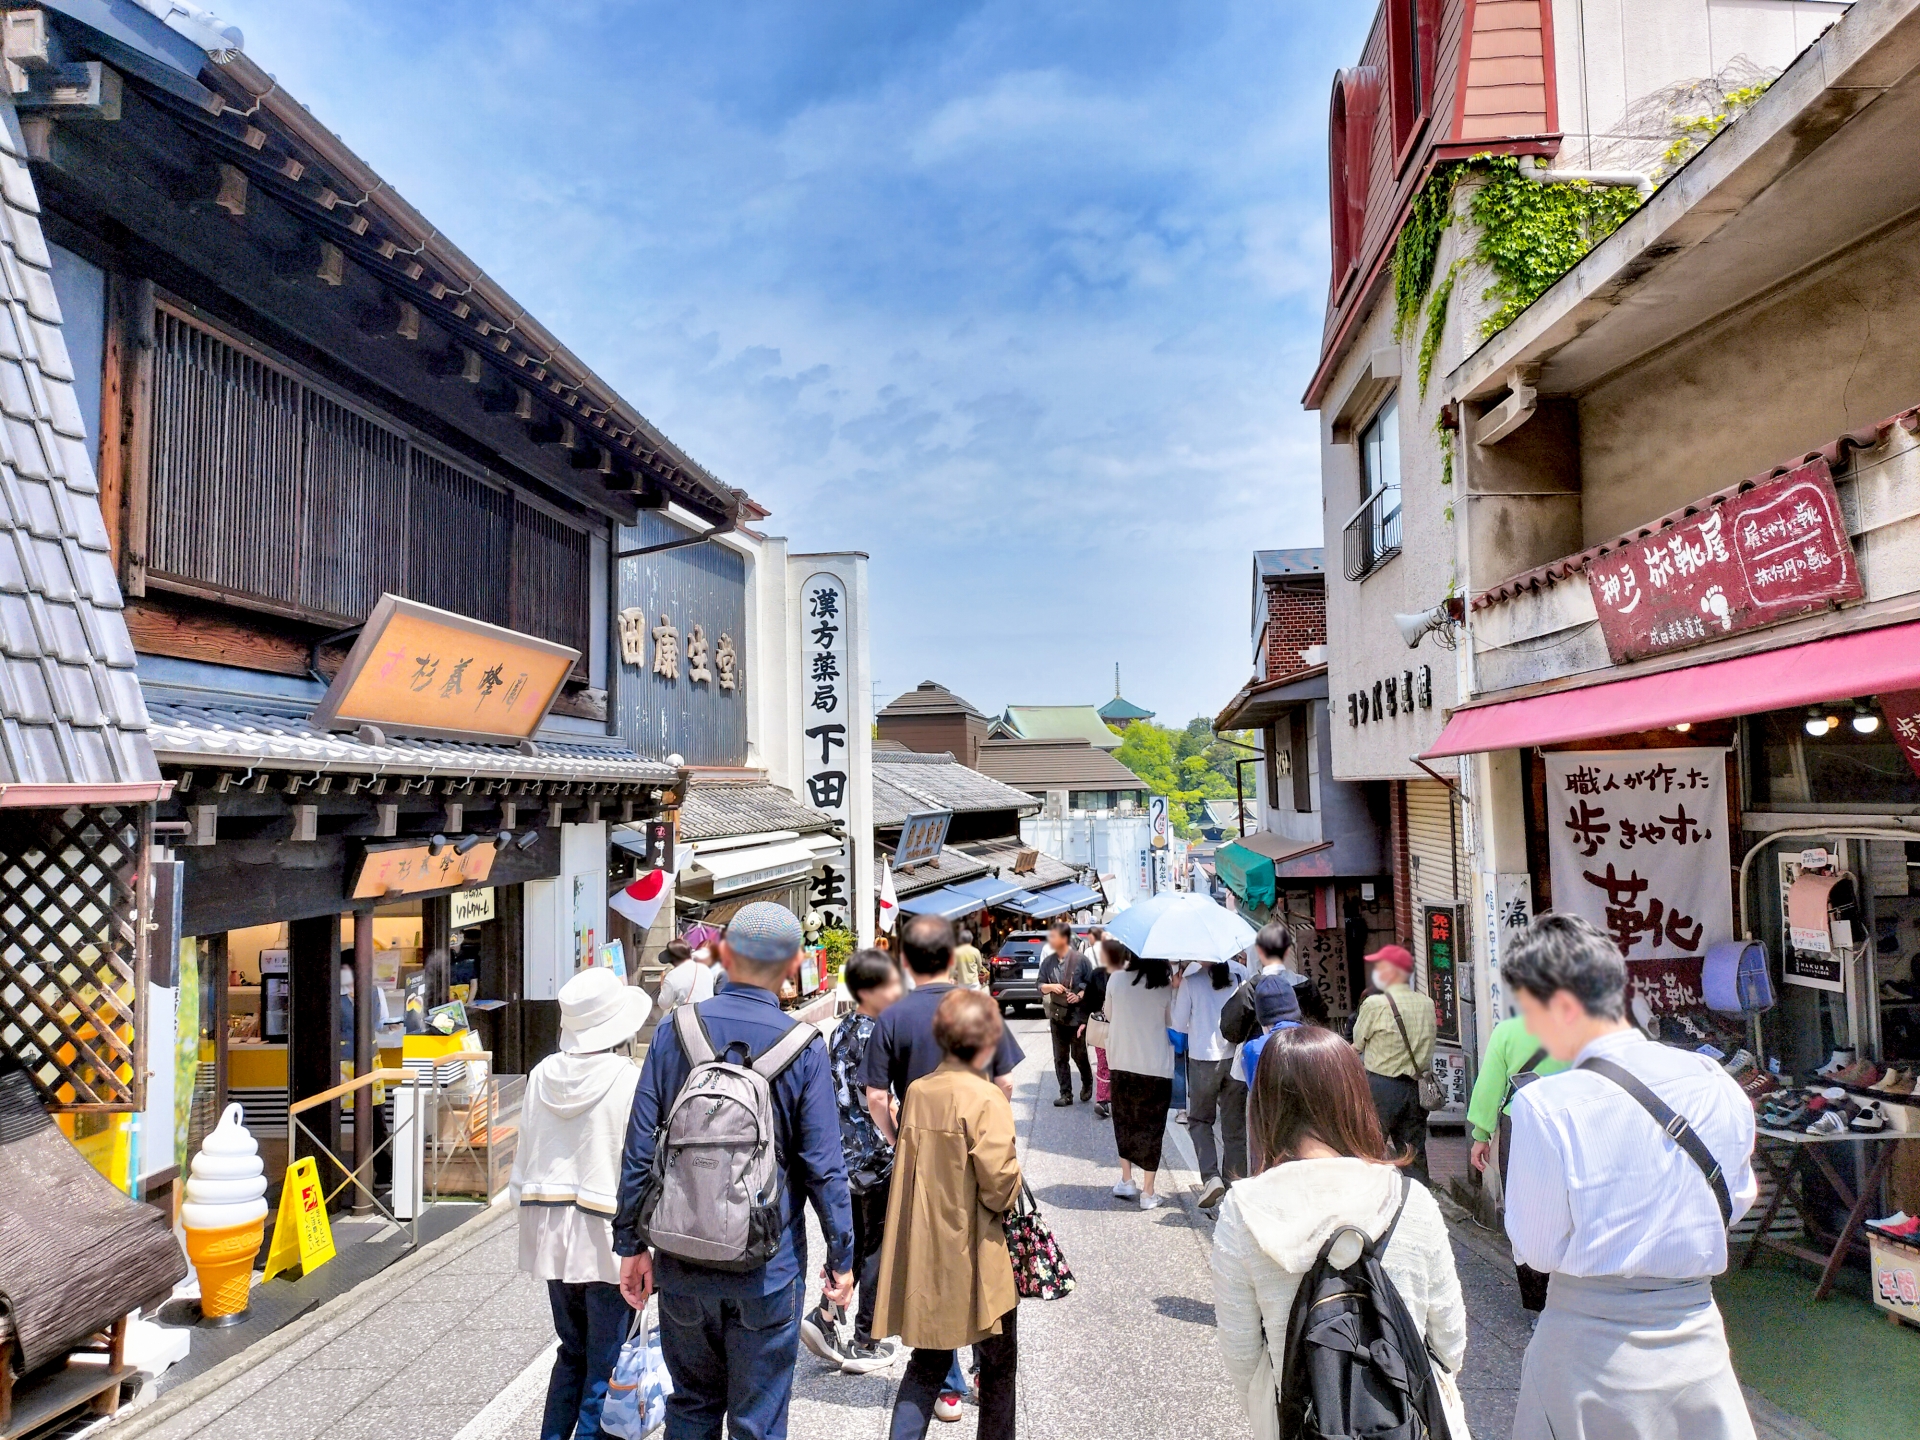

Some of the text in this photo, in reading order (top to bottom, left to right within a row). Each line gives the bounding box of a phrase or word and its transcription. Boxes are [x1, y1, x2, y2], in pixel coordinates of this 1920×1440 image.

[804, 588, 849, 928] 漢方薬局 下田生
[1564, 762, 1710, 797] 職人が作った
[1565, 799, 1713, 858] 歩きやすい
[1312, 934, 1335, 1005] おぐらや
